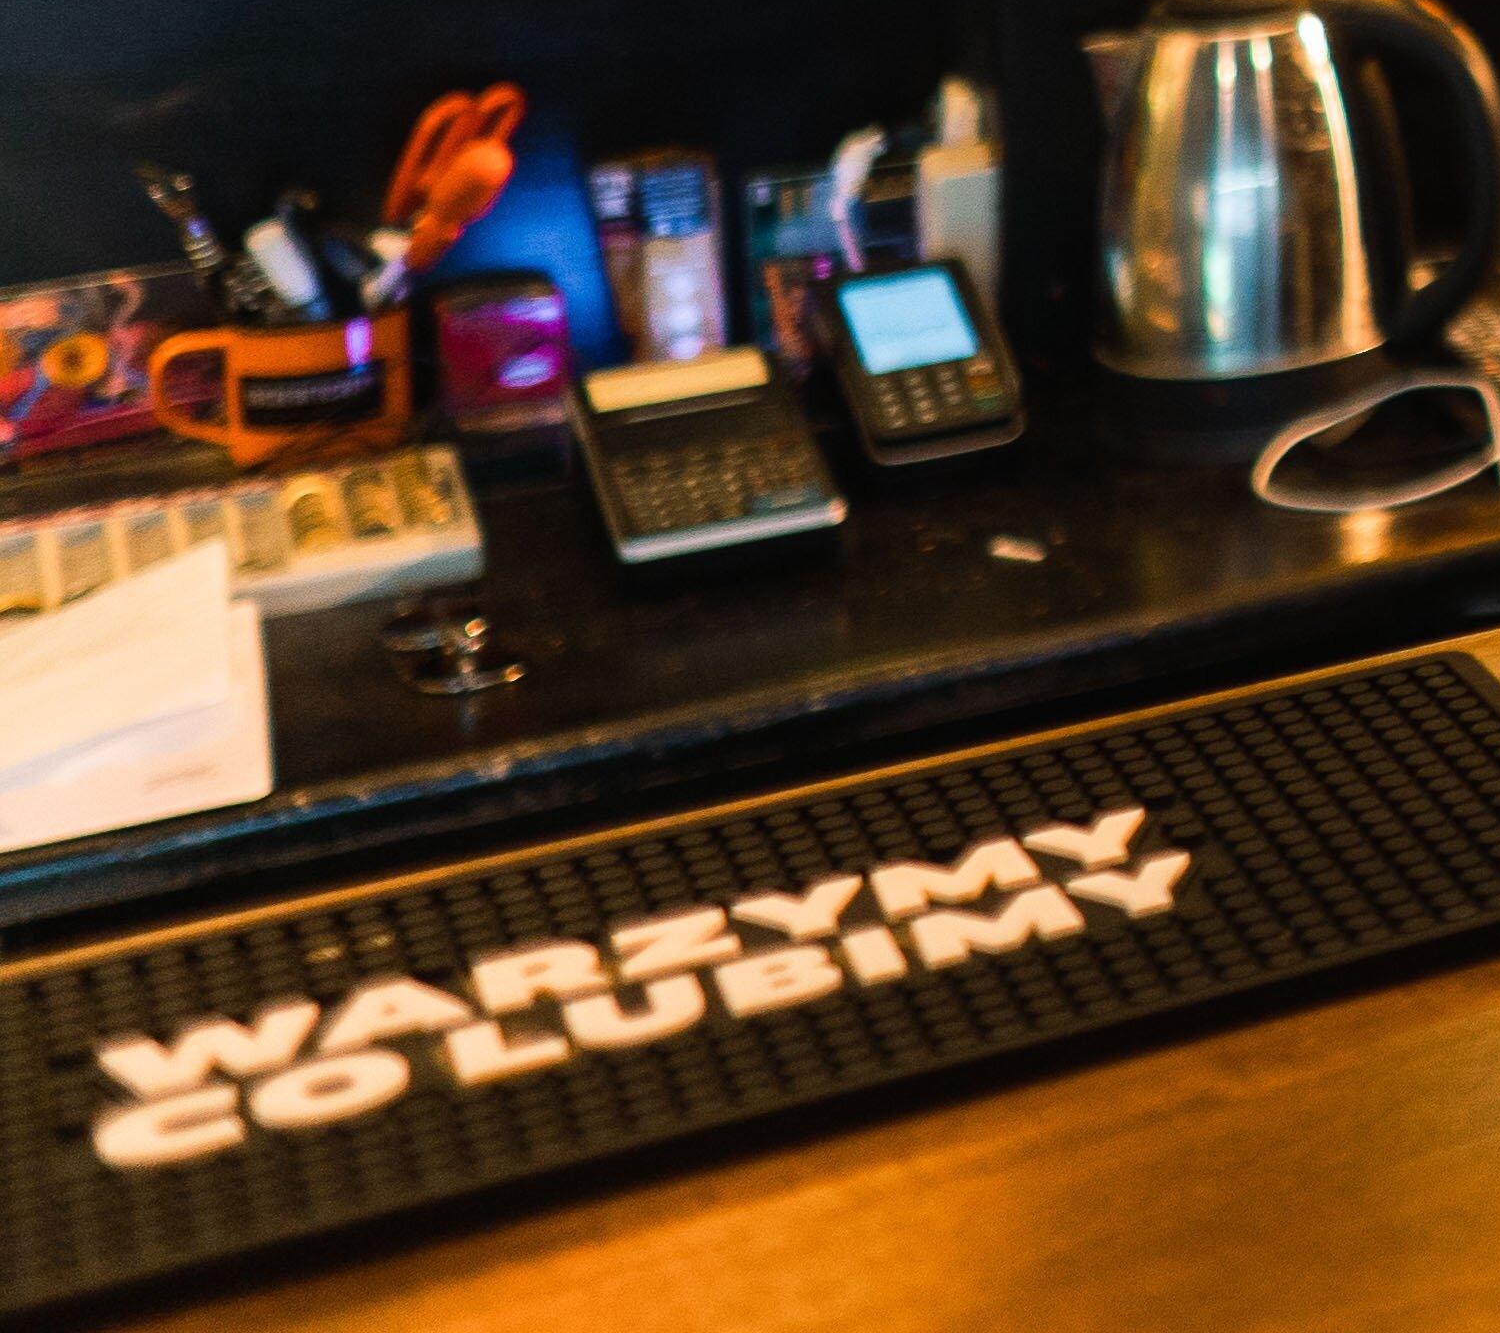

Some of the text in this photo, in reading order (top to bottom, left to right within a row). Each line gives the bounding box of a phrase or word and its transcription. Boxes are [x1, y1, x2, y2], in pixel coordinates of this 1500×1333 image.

[94, 847, 1193, 1172] CO LUBIMY
[98, 803, 1148, 1099] WARZYMY
